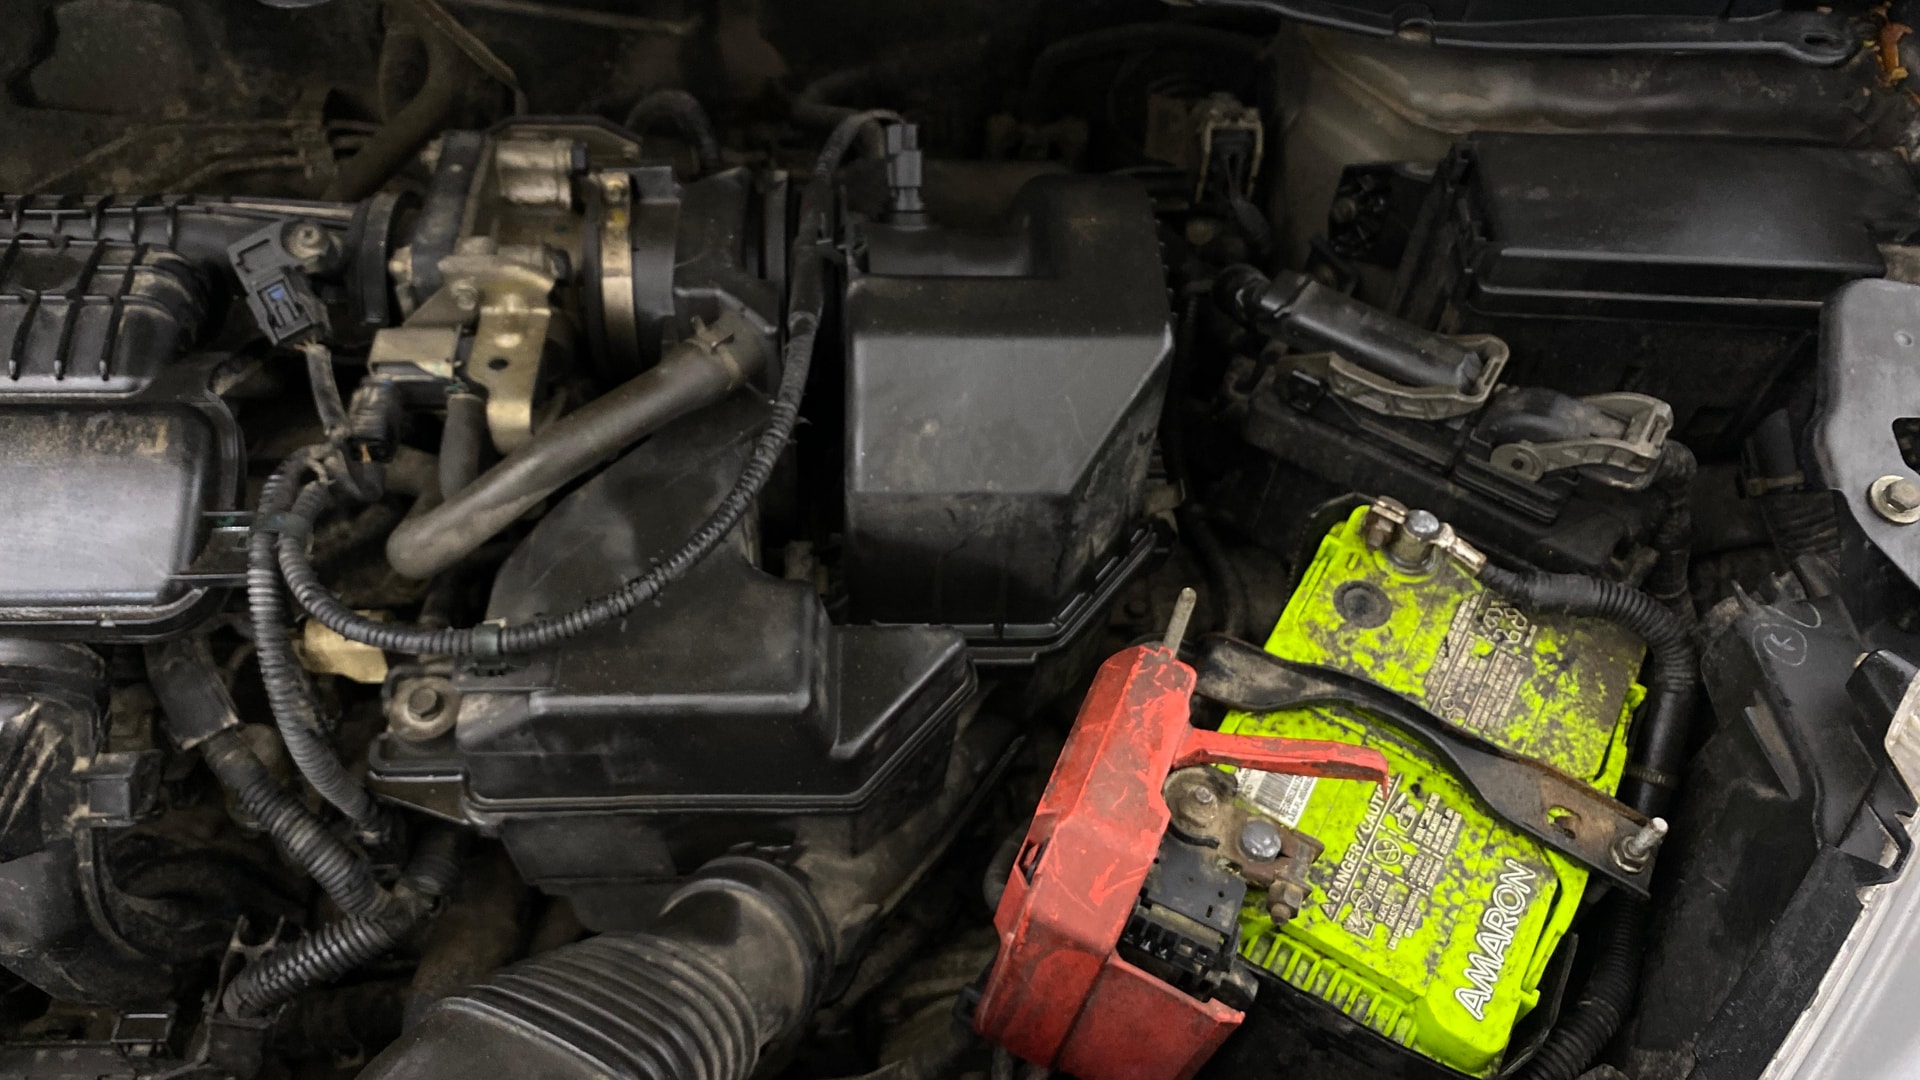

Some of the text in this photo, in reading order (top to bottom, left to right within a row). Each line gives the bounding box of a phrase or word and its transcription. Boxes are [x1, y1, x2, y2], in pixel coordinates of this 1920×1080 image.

[1400, 854, 1412, 868] NO
[1373, 878, 1388, 899] EYES
[1385, 902, 1403, 927] GASES
[1455, 858, 1537, 1020] AMARON
